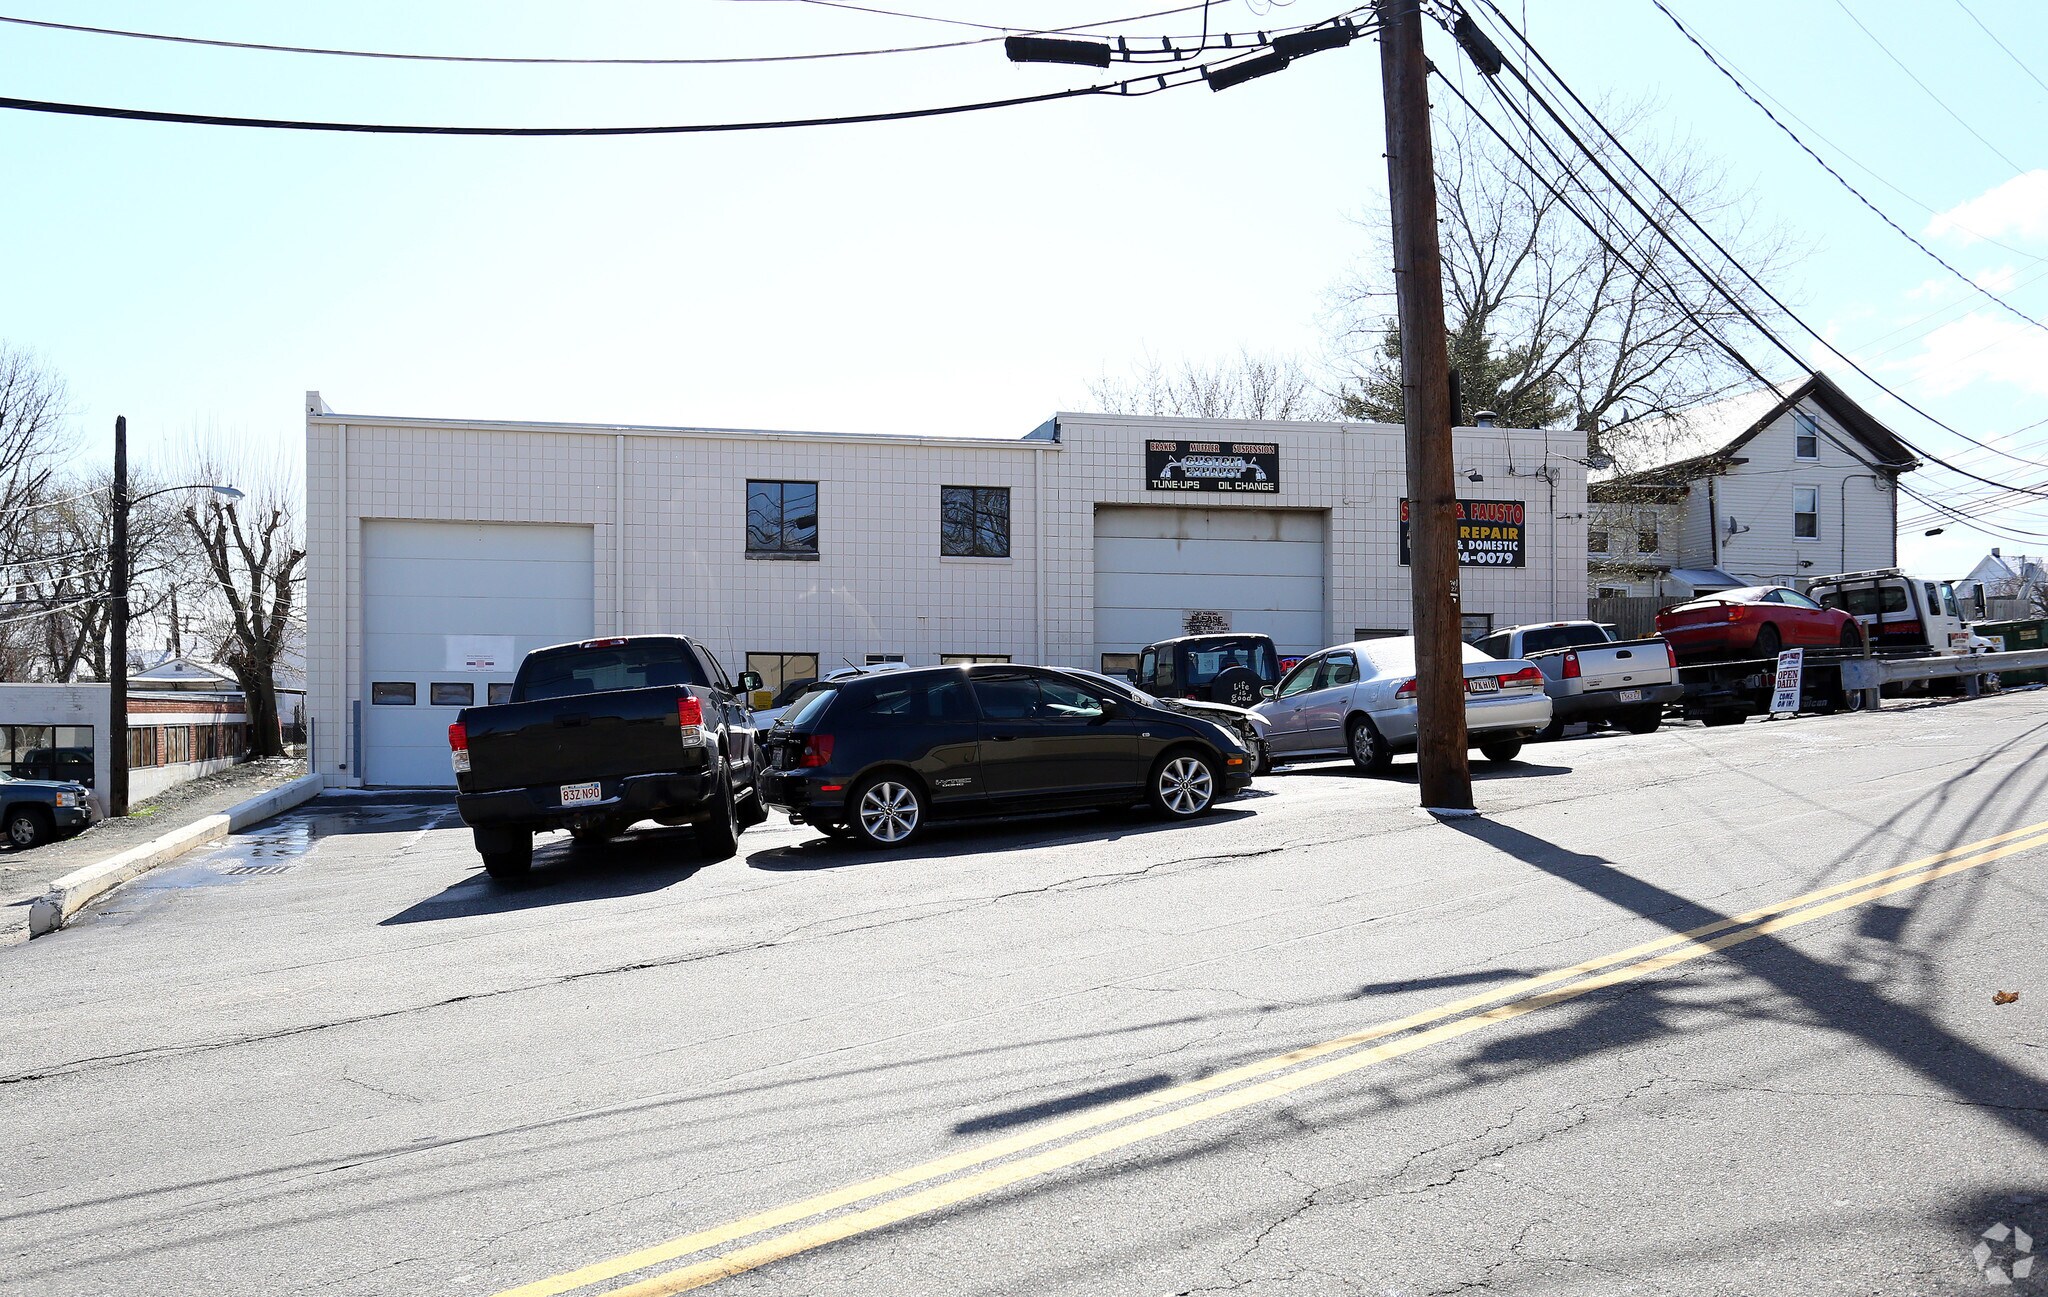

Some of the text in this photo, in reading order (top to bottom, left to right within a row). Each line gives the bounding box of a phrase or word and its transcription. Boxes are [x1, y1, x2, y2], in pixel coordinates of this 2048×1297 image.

[1150, 442, 1275, 454] BRAKES MUFFLER SUSPENSION
[1185, 455, 1243, 467] CUSTOM
[1185, 467, 1242, 478] EXHAUST
[1152, 480, 1275, 491] TUNE-UPS OIL CHANGE
[1471, 503, 1524, 525] FAUSTO
[1460, 526, 1519, 540] REPAIR
[1468, 540, 1519, 551] DOMESTIC
[1457, 552, 1514, 564] 4-0079
[1778, 670, 1798, 679] OPEN
[1233, 681, 1250, 690] Life
[1777, 679, 1798, 688] DAILY
[1230, 694, 1253, 704] good
[1803, 699, 1828, 708] ulcan
